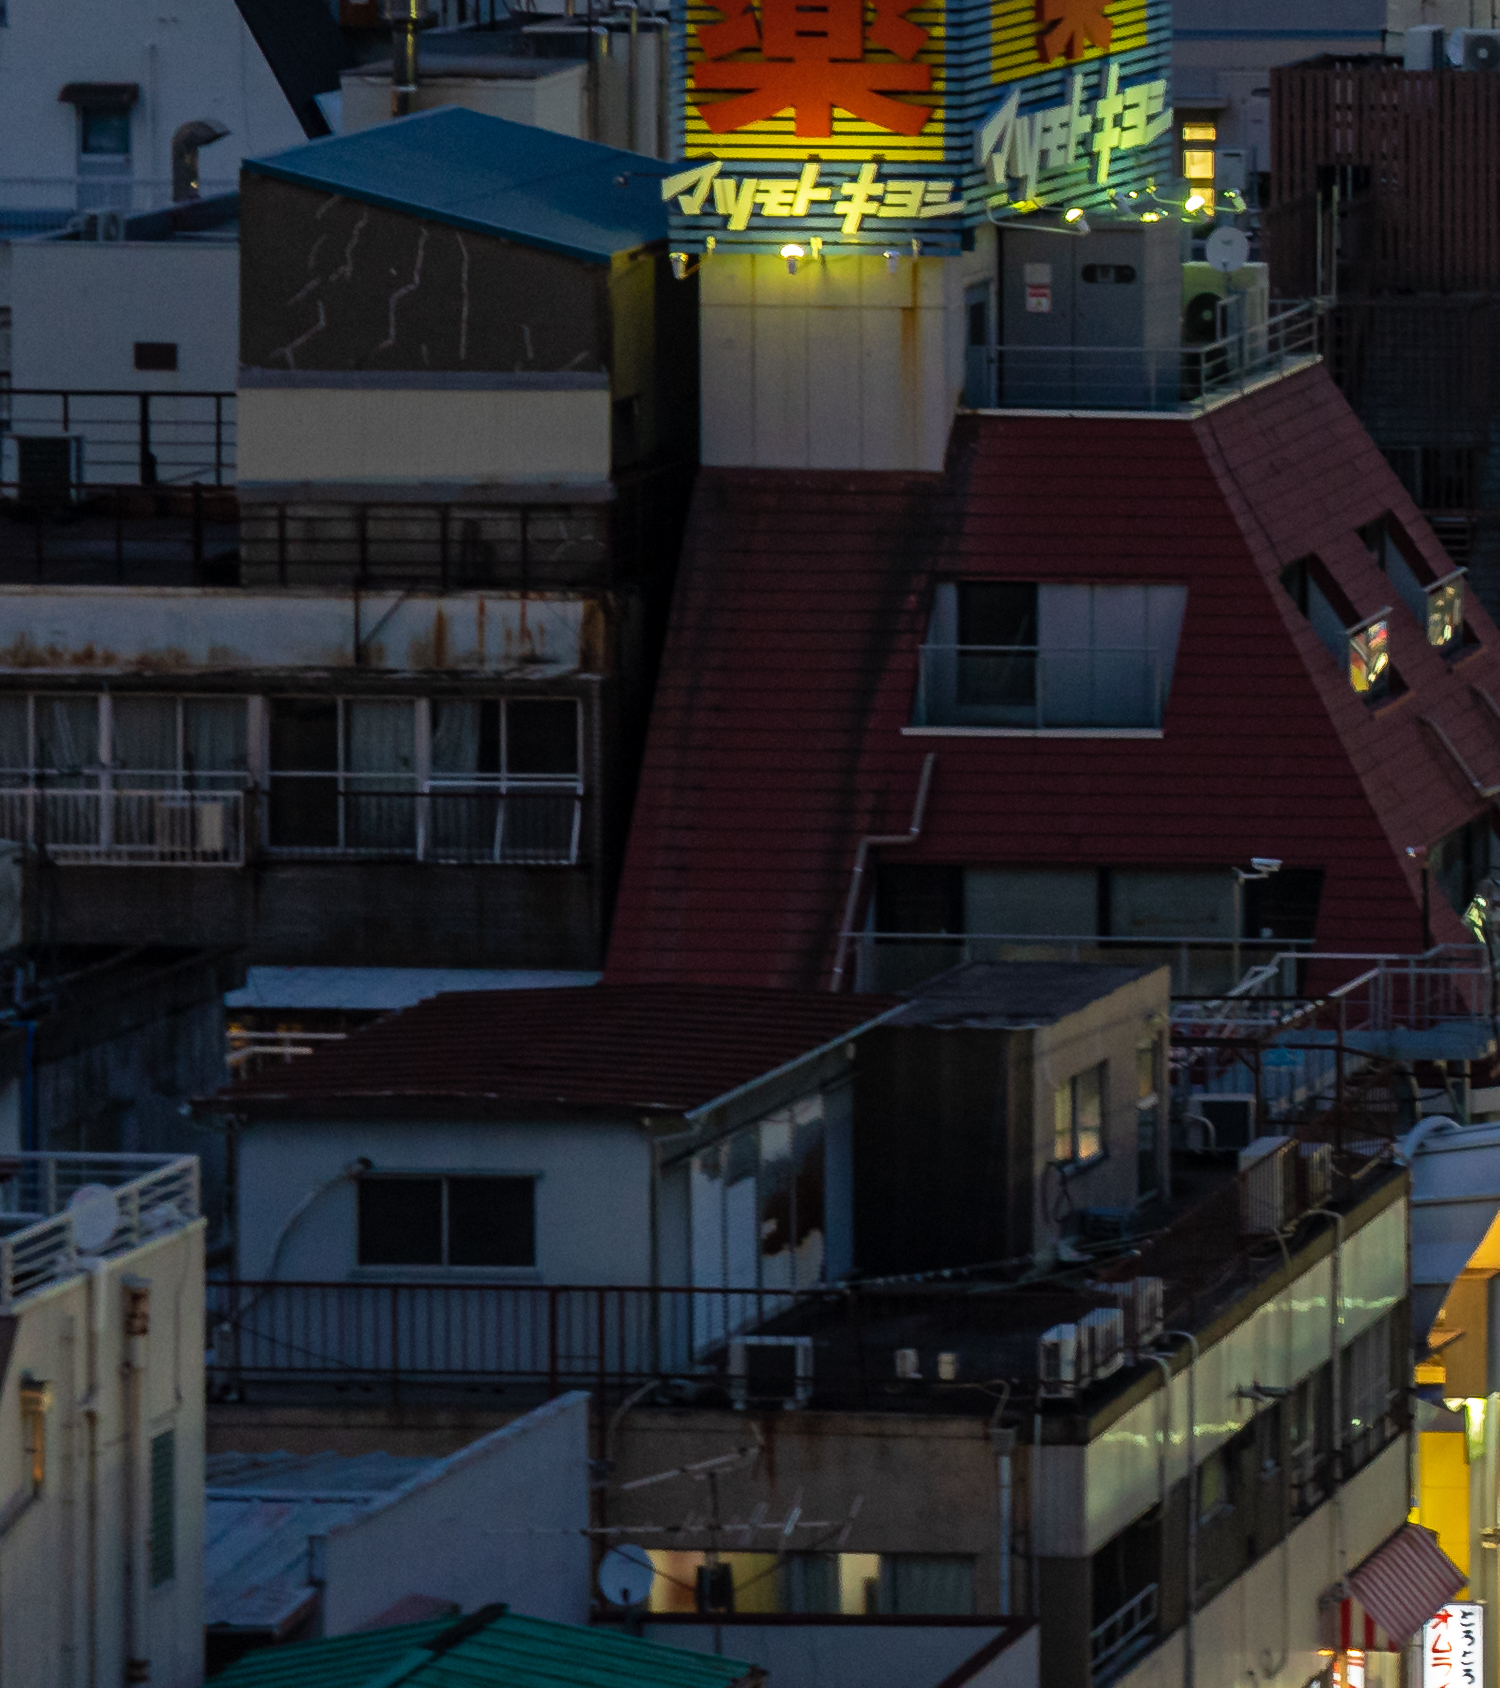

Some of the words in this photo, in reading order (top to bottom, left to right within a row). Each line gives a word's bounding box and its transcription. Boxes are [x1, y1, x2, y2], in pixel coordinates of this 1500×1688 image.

[661, 161, 966, 233] マツモトキヨシ
